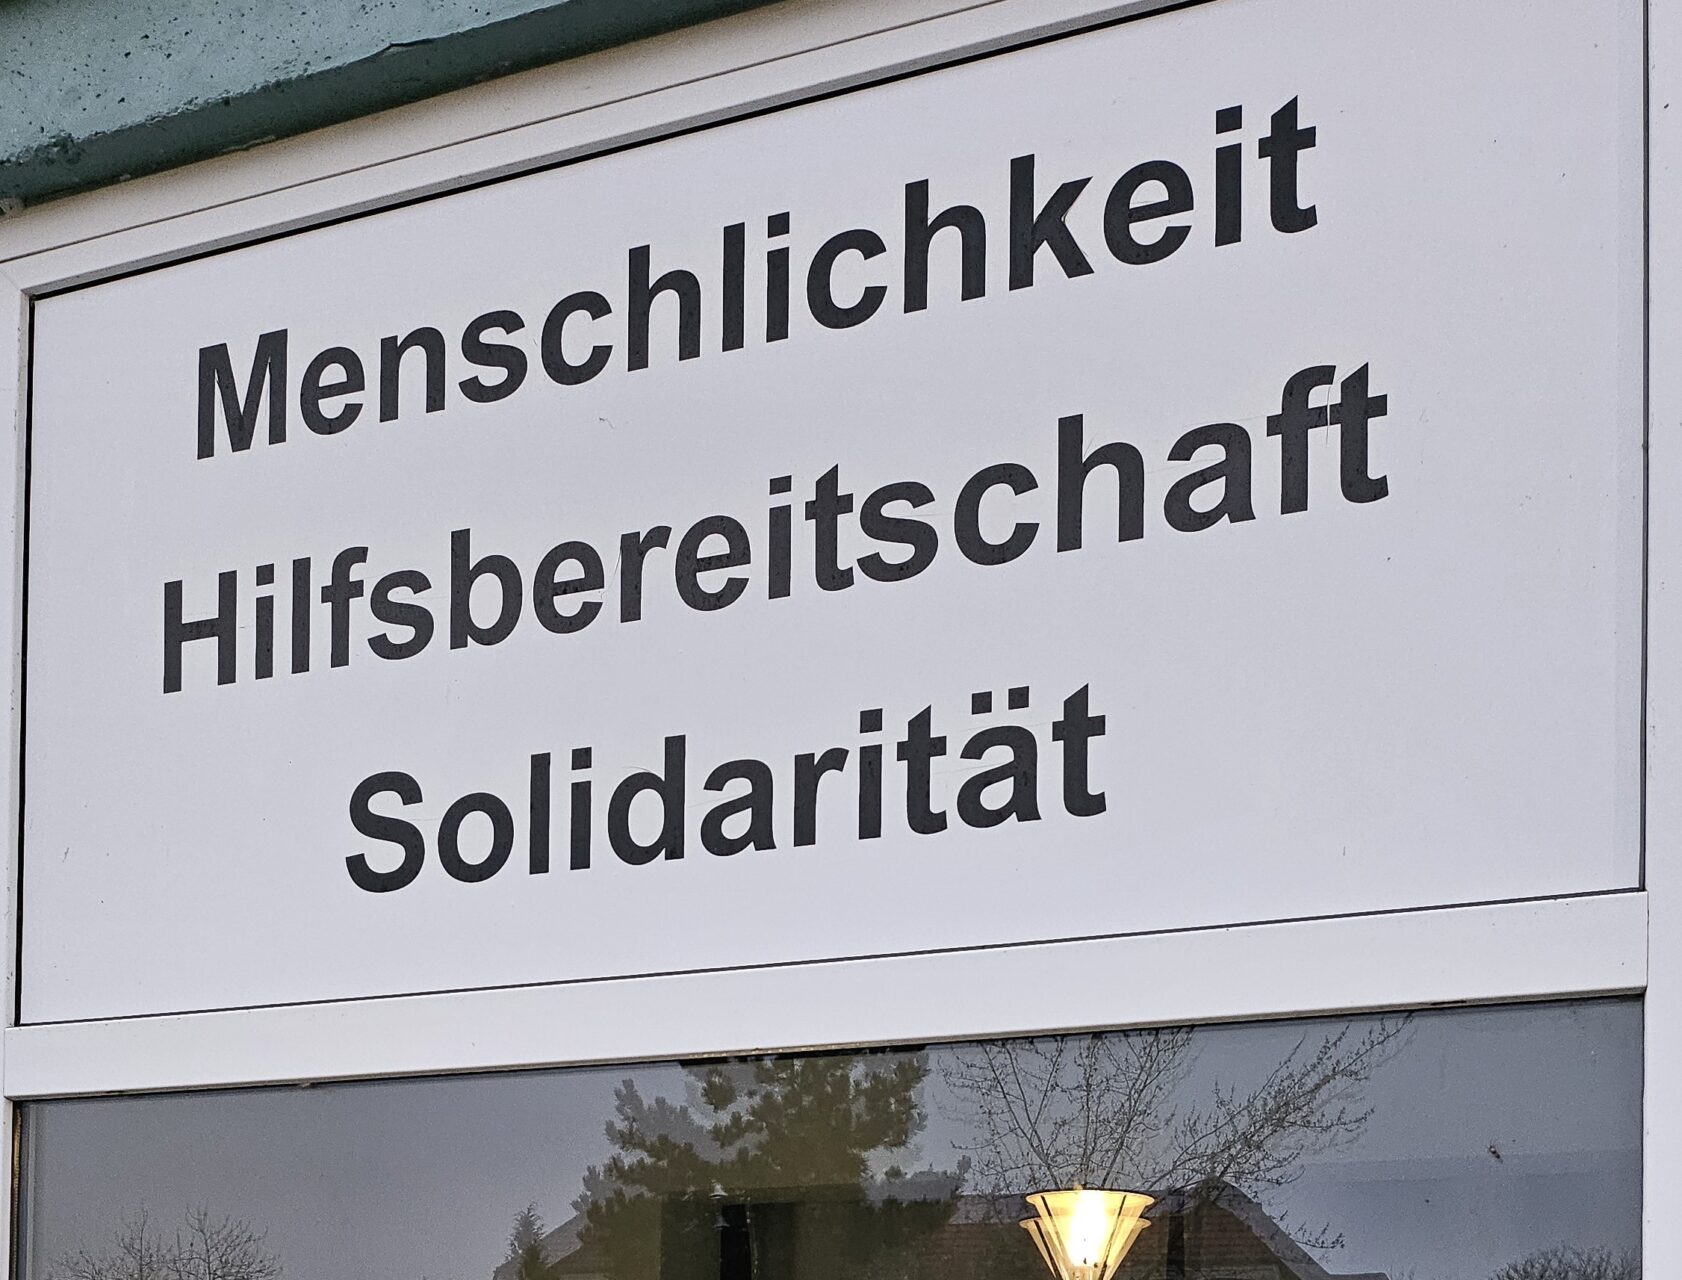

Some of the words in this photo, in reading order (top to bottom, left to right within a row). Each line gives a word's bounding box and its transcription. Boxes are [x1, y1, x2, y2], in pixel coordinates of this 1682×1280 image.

[196, 94, 1318, 461] Menschlichkeit
[163, 361, 1389, 695] Hilfsbereitschaft
[345, 682, 1107, 894] Solidarität
